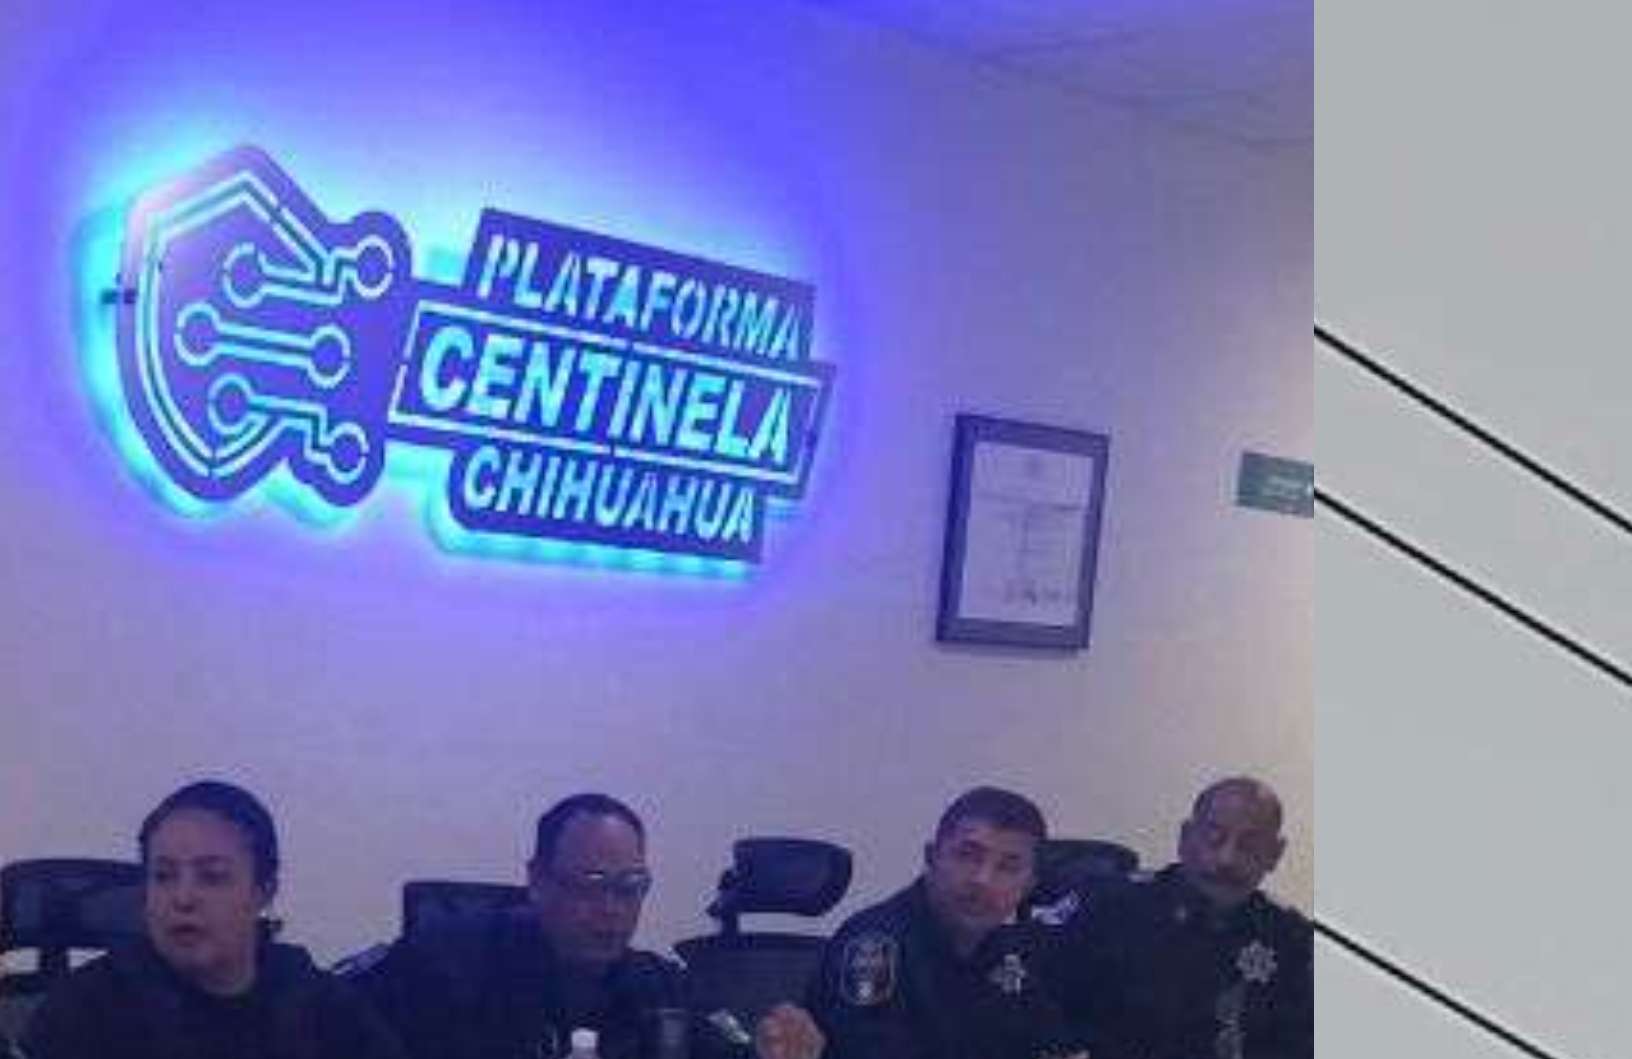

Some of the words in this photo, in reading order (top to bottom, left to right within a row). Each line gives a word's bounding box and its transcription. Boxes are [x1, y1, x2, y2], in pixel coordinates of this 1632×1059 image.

[478, 235, 799, 359] PLATAFORMA
[419, 325, 793, 463] CENTINELA
[462, 445, 755, 543] CHIHUAHUA
